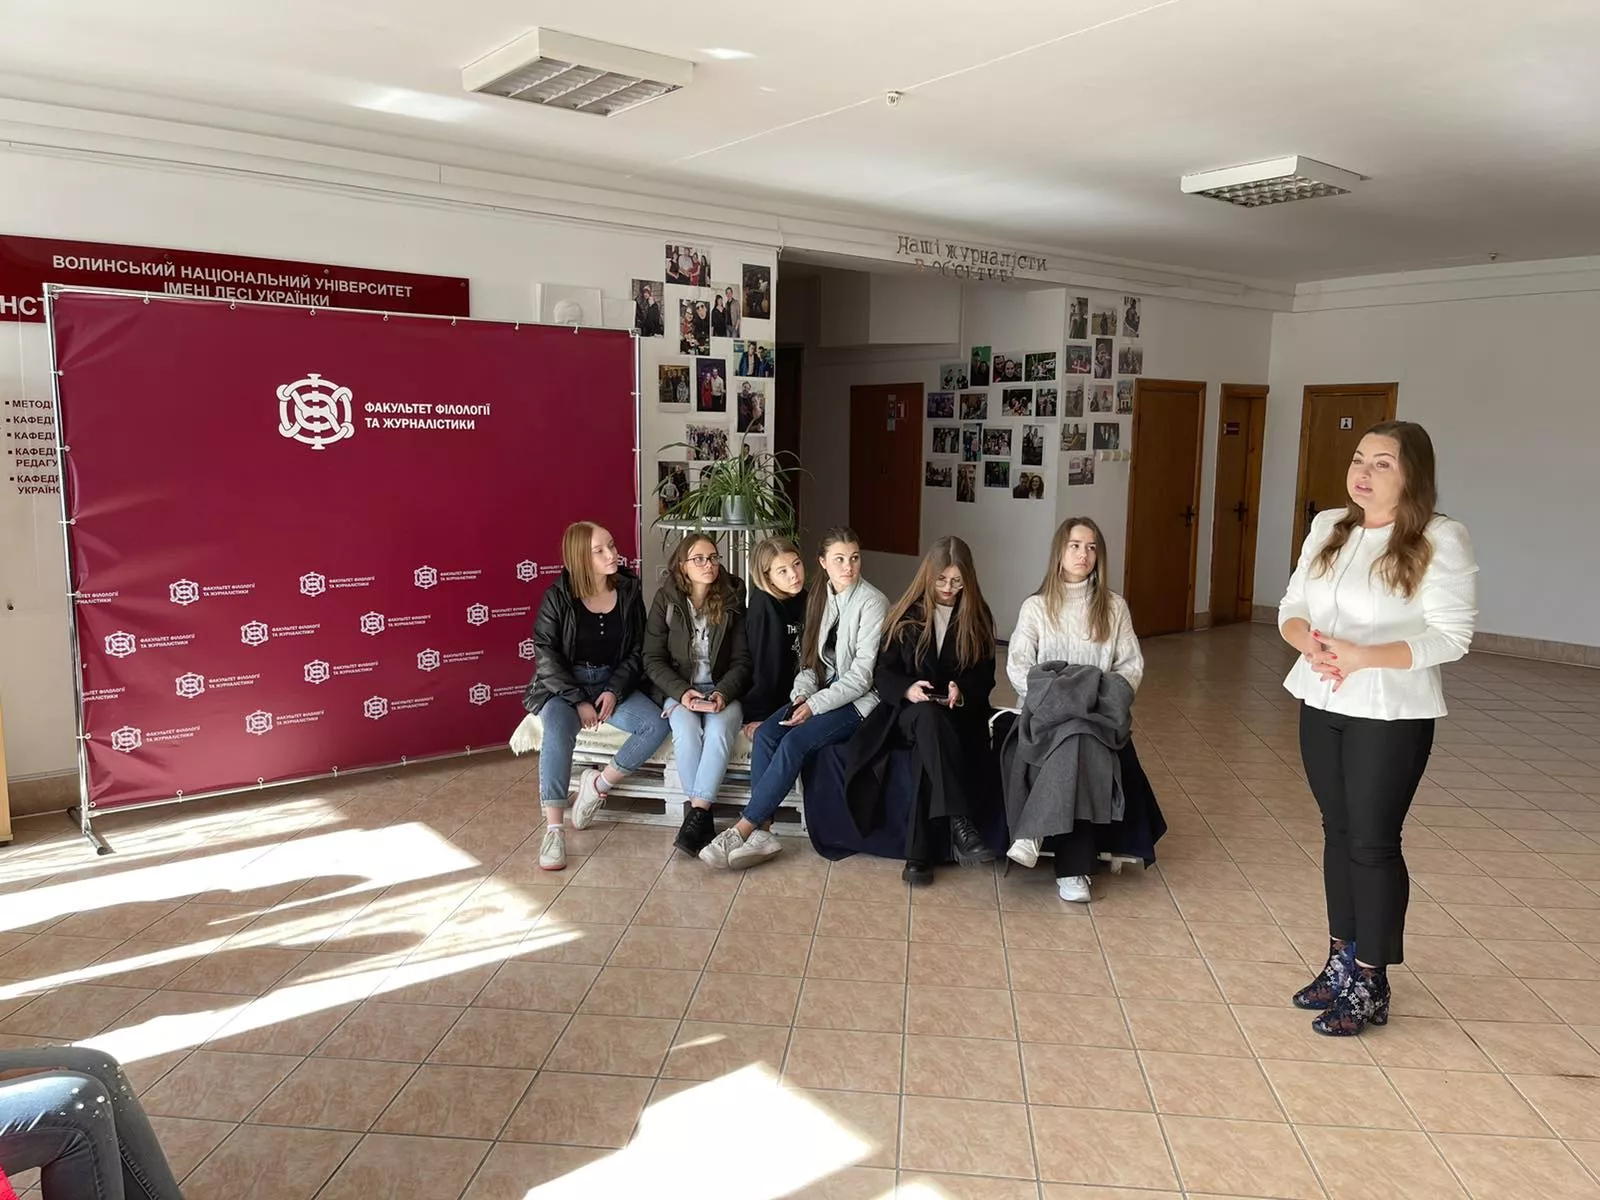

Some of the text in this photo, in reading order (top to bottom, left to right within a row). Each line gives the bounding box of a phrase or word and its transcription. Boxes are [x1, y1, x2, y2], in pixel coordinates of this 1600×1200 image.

[896, 235, 1049, 271] Наші журналісти
[53, 255, 413, 297] ВОЛИНСЬКИЙ НАЦІОНАЛЬНИЙ УНІВЕРСИТЕТ
[164, 282, 330, 306] ІМЕНІ ЛЕСІ УКРАЇНКИ
[12, 400, 54, 409] МЕТОД
[364, 401, 491, 416] ФАКУЛЬТЕТ ФІЛОЛОГІЇ
[13, 416, 54, 424] КАФЕД
[365, 417, 476, 430] ТА ЖУРНАЛІСТИКИ
[15, 448, 56, 456] КАФЕД
